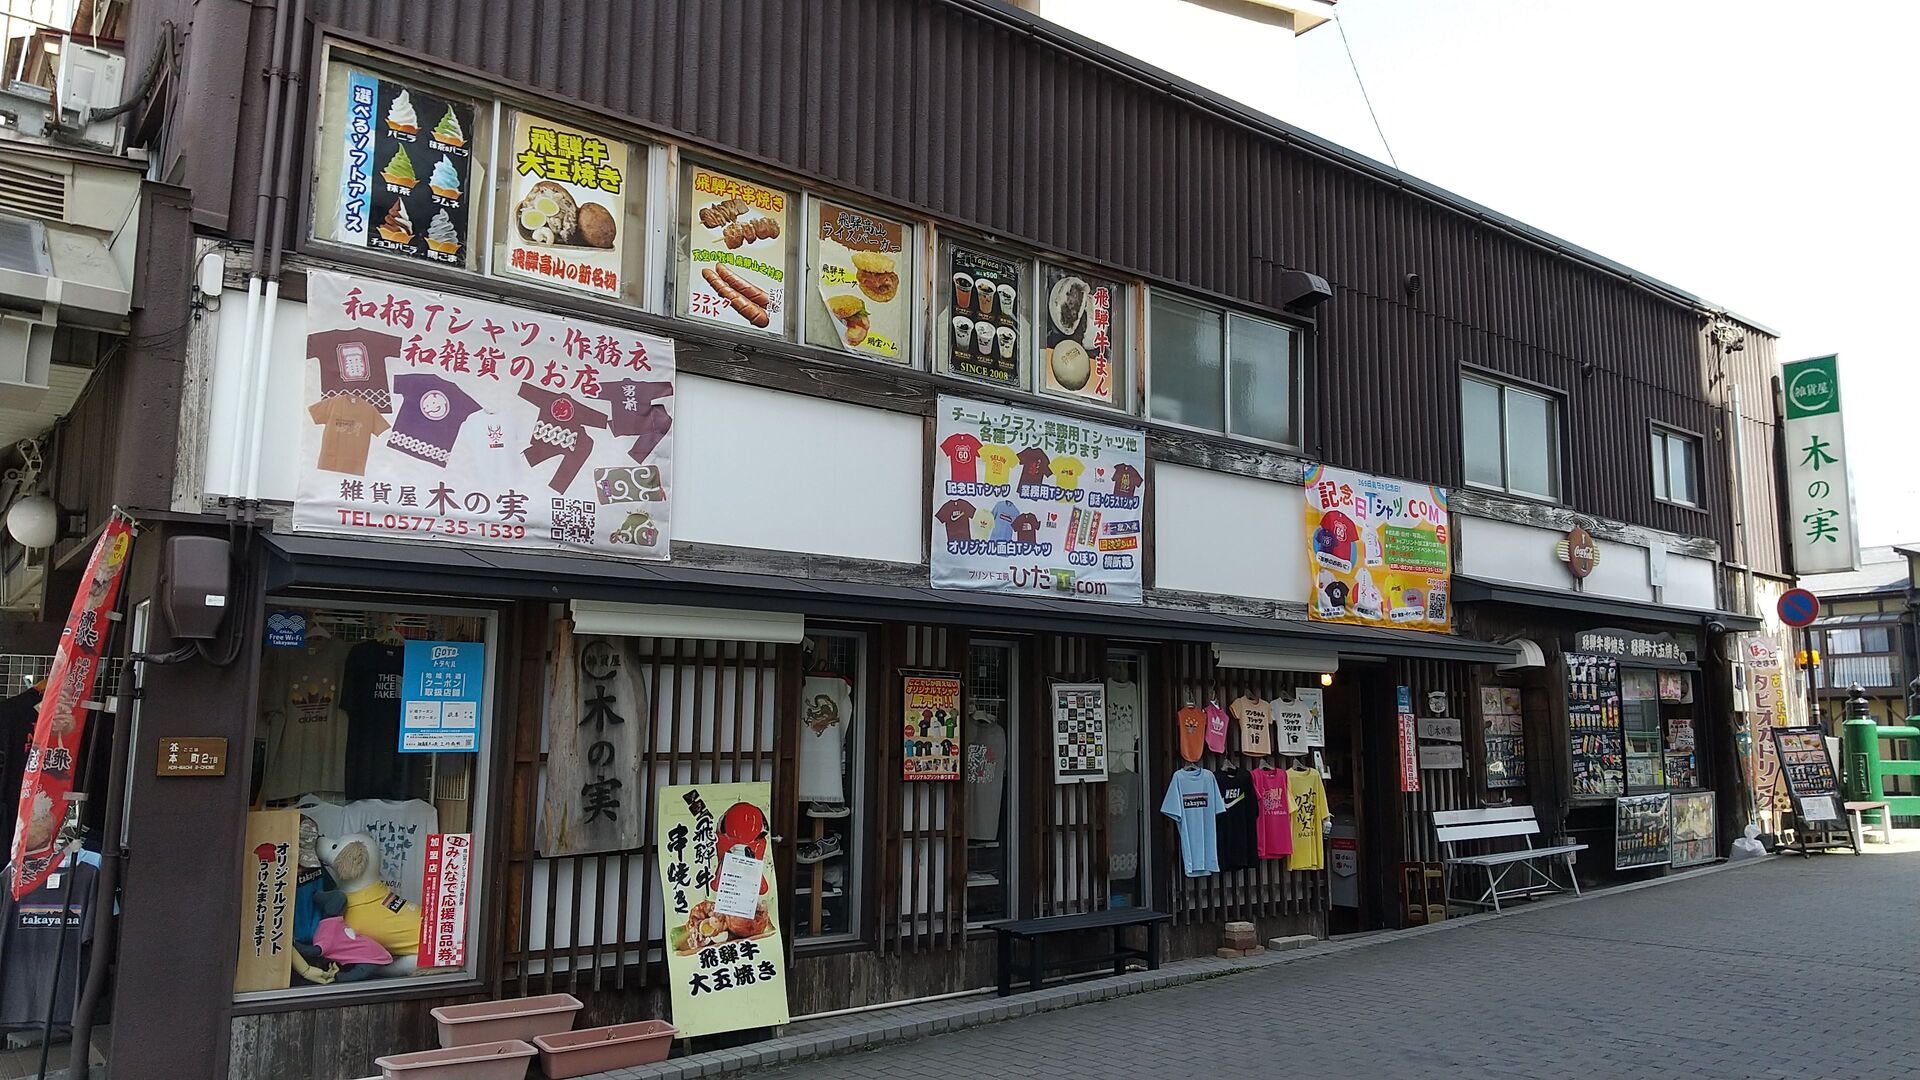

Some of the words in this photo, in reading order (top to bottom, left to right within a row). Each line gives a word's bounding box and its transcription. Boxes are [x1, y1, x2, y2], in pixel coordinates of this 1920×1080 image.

[387, 130, 416, 143] バニラ
[530, 128, 609, 165] 飛騨牛
[346, 85, 373, 234] 選べるソフトアイス
[517, 152, 622, 193] 大玉焼き
[386, 183, 411, 196] 抹茶
[432, 195, 460, 208] ラムネ
[694, 173, 784, 212] 飛騨牛串焼き
[822, 223, 901, 252] ライスバーガー
[837, 213, 887, 237] 飛騨高山
[511, 248, 617, 292] 飛騨高山の新名物
[692, 292, 731, 309] フランク
[692, 303, 720, 317] フルト
[1093, 287, 1110, 397] 飛騨牛まん
[402, 335, 602, 398] 和雑貨のお店
[960, 362, 988, 376] SINCE
[989, 367, 1009, 380] 2008
[622, 384, 638, 412] 男前
[958, 451, 969, 460] 60
[979, 427, 1102, 460] 各種プリント承ります
[946, 481, 1011, 498] 記念日Tシャツ
[1021, 484, 1085, 502] 業務用Tシャツ
[1799, 435, 1840, 545] 木の実
[337, 508, 526, 540] TEL.0577-35-1539
[948, 540, 1052, 557] オリジナル面白Tシャツ
[1068, 551, 1097, 566] のぼり
[269, 633, 284, 641] Free
[1749, 643, 1776, 659] ほっと
[378, 673, 396, 683] THE
[433, 660, 456, 668] トラベル
[374, 690, 396, 699] FAKE
[375, 682, 396, 691] NICE
[425, 680, 462, 688] クーポン
[1245, 710, 1265, 718] ワンちゃん
[579, 685, 625, 825] 木の実
[1754, 674, 1775, 810] タピオカドリンク
[428, 837, 440, 873] 加盟店
[666, 823, 691, 914] 串焼き
[692, 817, 717, 897] 飛騨牛
[254, 861, 269, 957] うけたまわります!
[271, 843, 290, 955] オリジナルプリント
[437, 846, 460, 961] みんなで応援商品券
[699, 941, 760, 970] 飛騨牛
[688, 960, 777, 997] 大玉焼き
